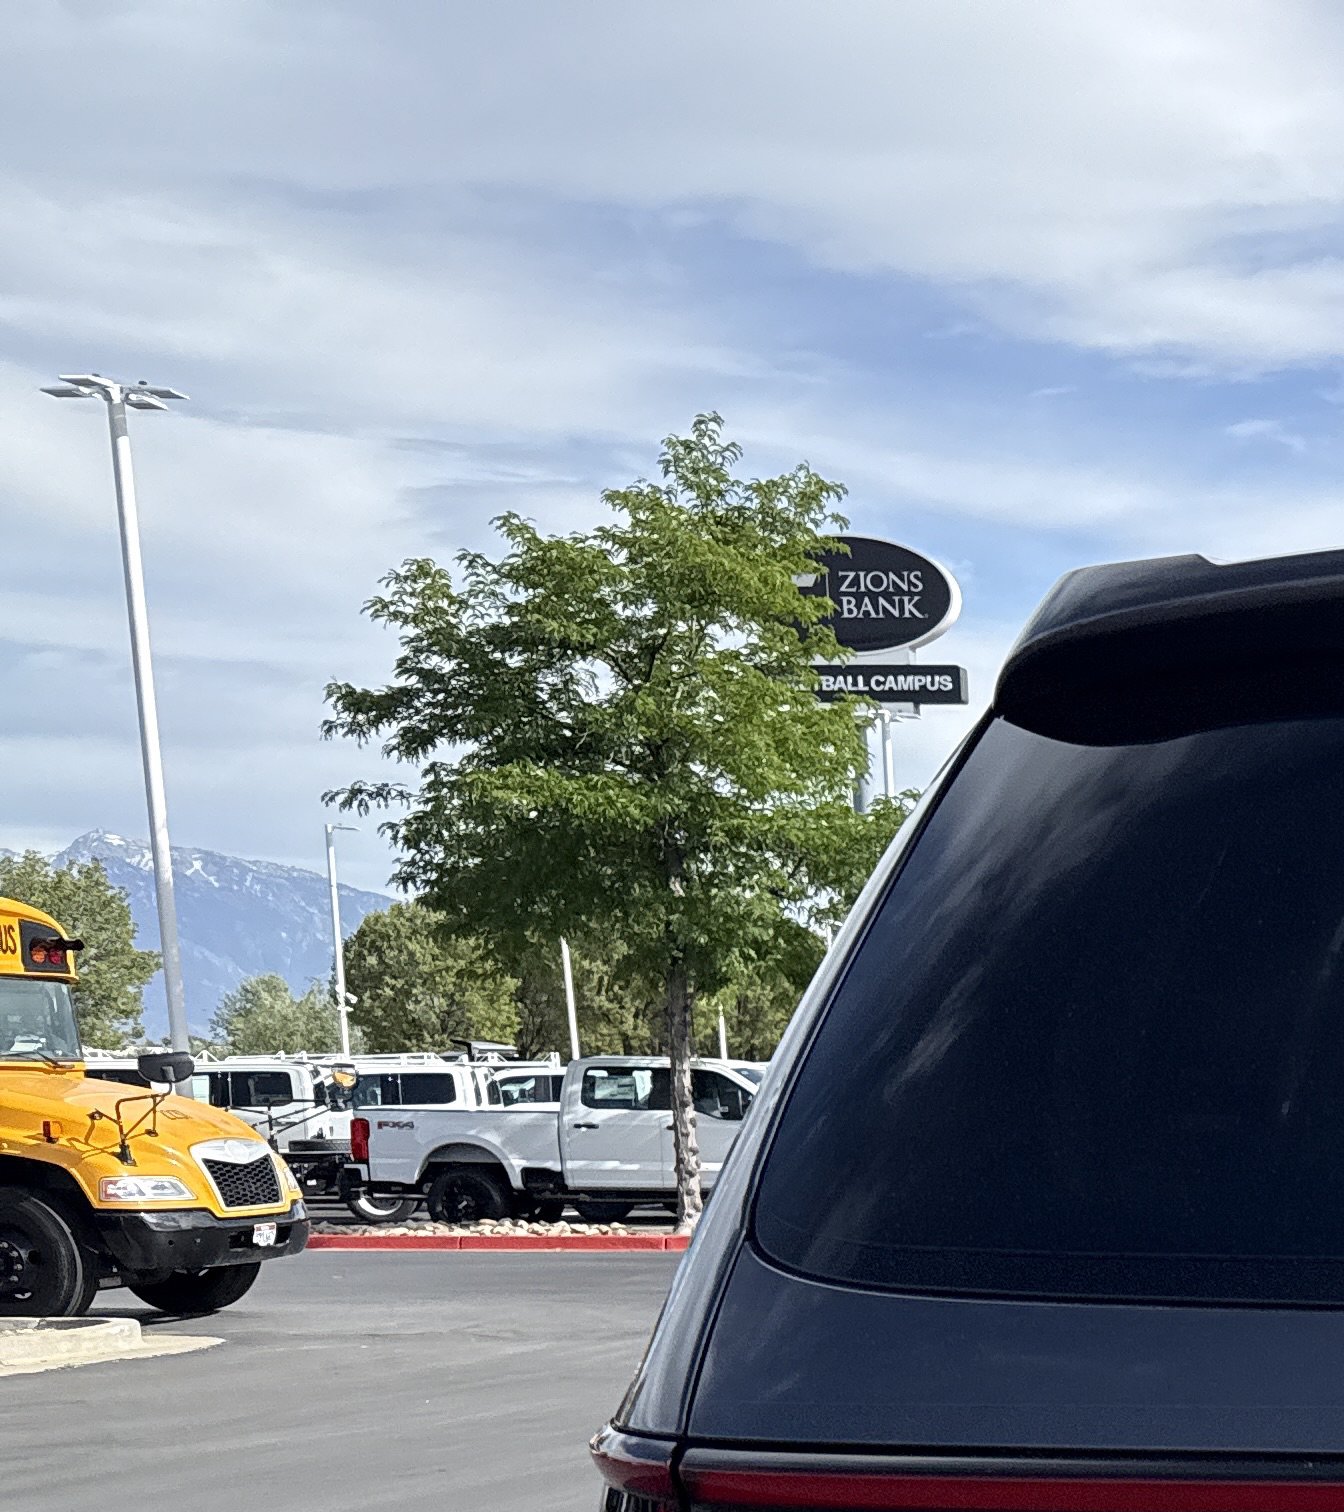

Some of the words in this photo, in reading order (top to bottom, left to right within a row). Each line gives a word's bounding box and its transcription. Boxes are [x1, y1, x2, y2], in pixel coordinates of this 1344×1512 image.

[838, 571, 923, 592] ZIONS
[840, 596, 925, 618] BANK
[796, 674, 869, 691] BALL
[870, 675, 952, 691] CAMPUS
